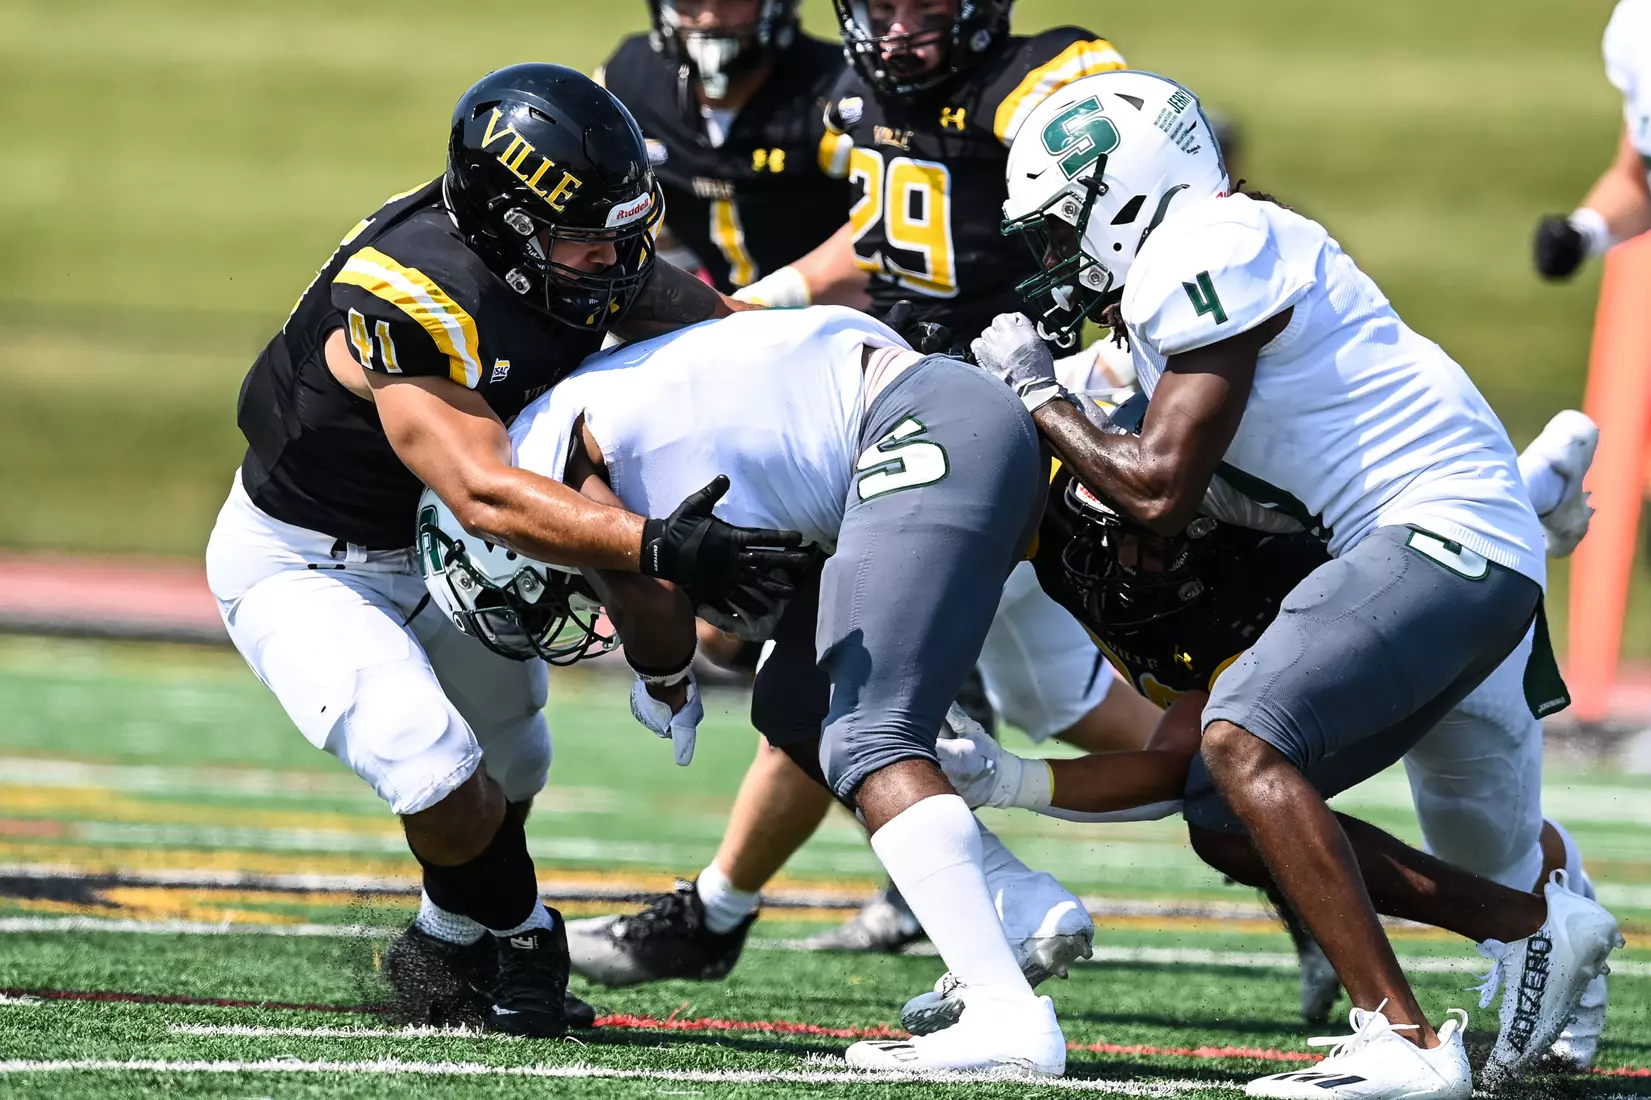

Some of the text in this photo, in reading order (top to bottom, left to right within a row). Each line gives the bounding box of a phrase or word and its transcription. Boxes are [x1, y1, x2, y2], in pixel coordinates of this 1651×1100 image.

[481, 107, 583, 214] VILLE
[1040, 94, 1121, 181] S
[616, 198, 650, 220] Riddell
[709, 199, 760, 287] 1
[848, 147, 960, 299] 29
[347, 306, 403, 374] 41
[1181, 270, 1229, 325] 4
[1507, 935, 1553, 1054] ADIZERO
